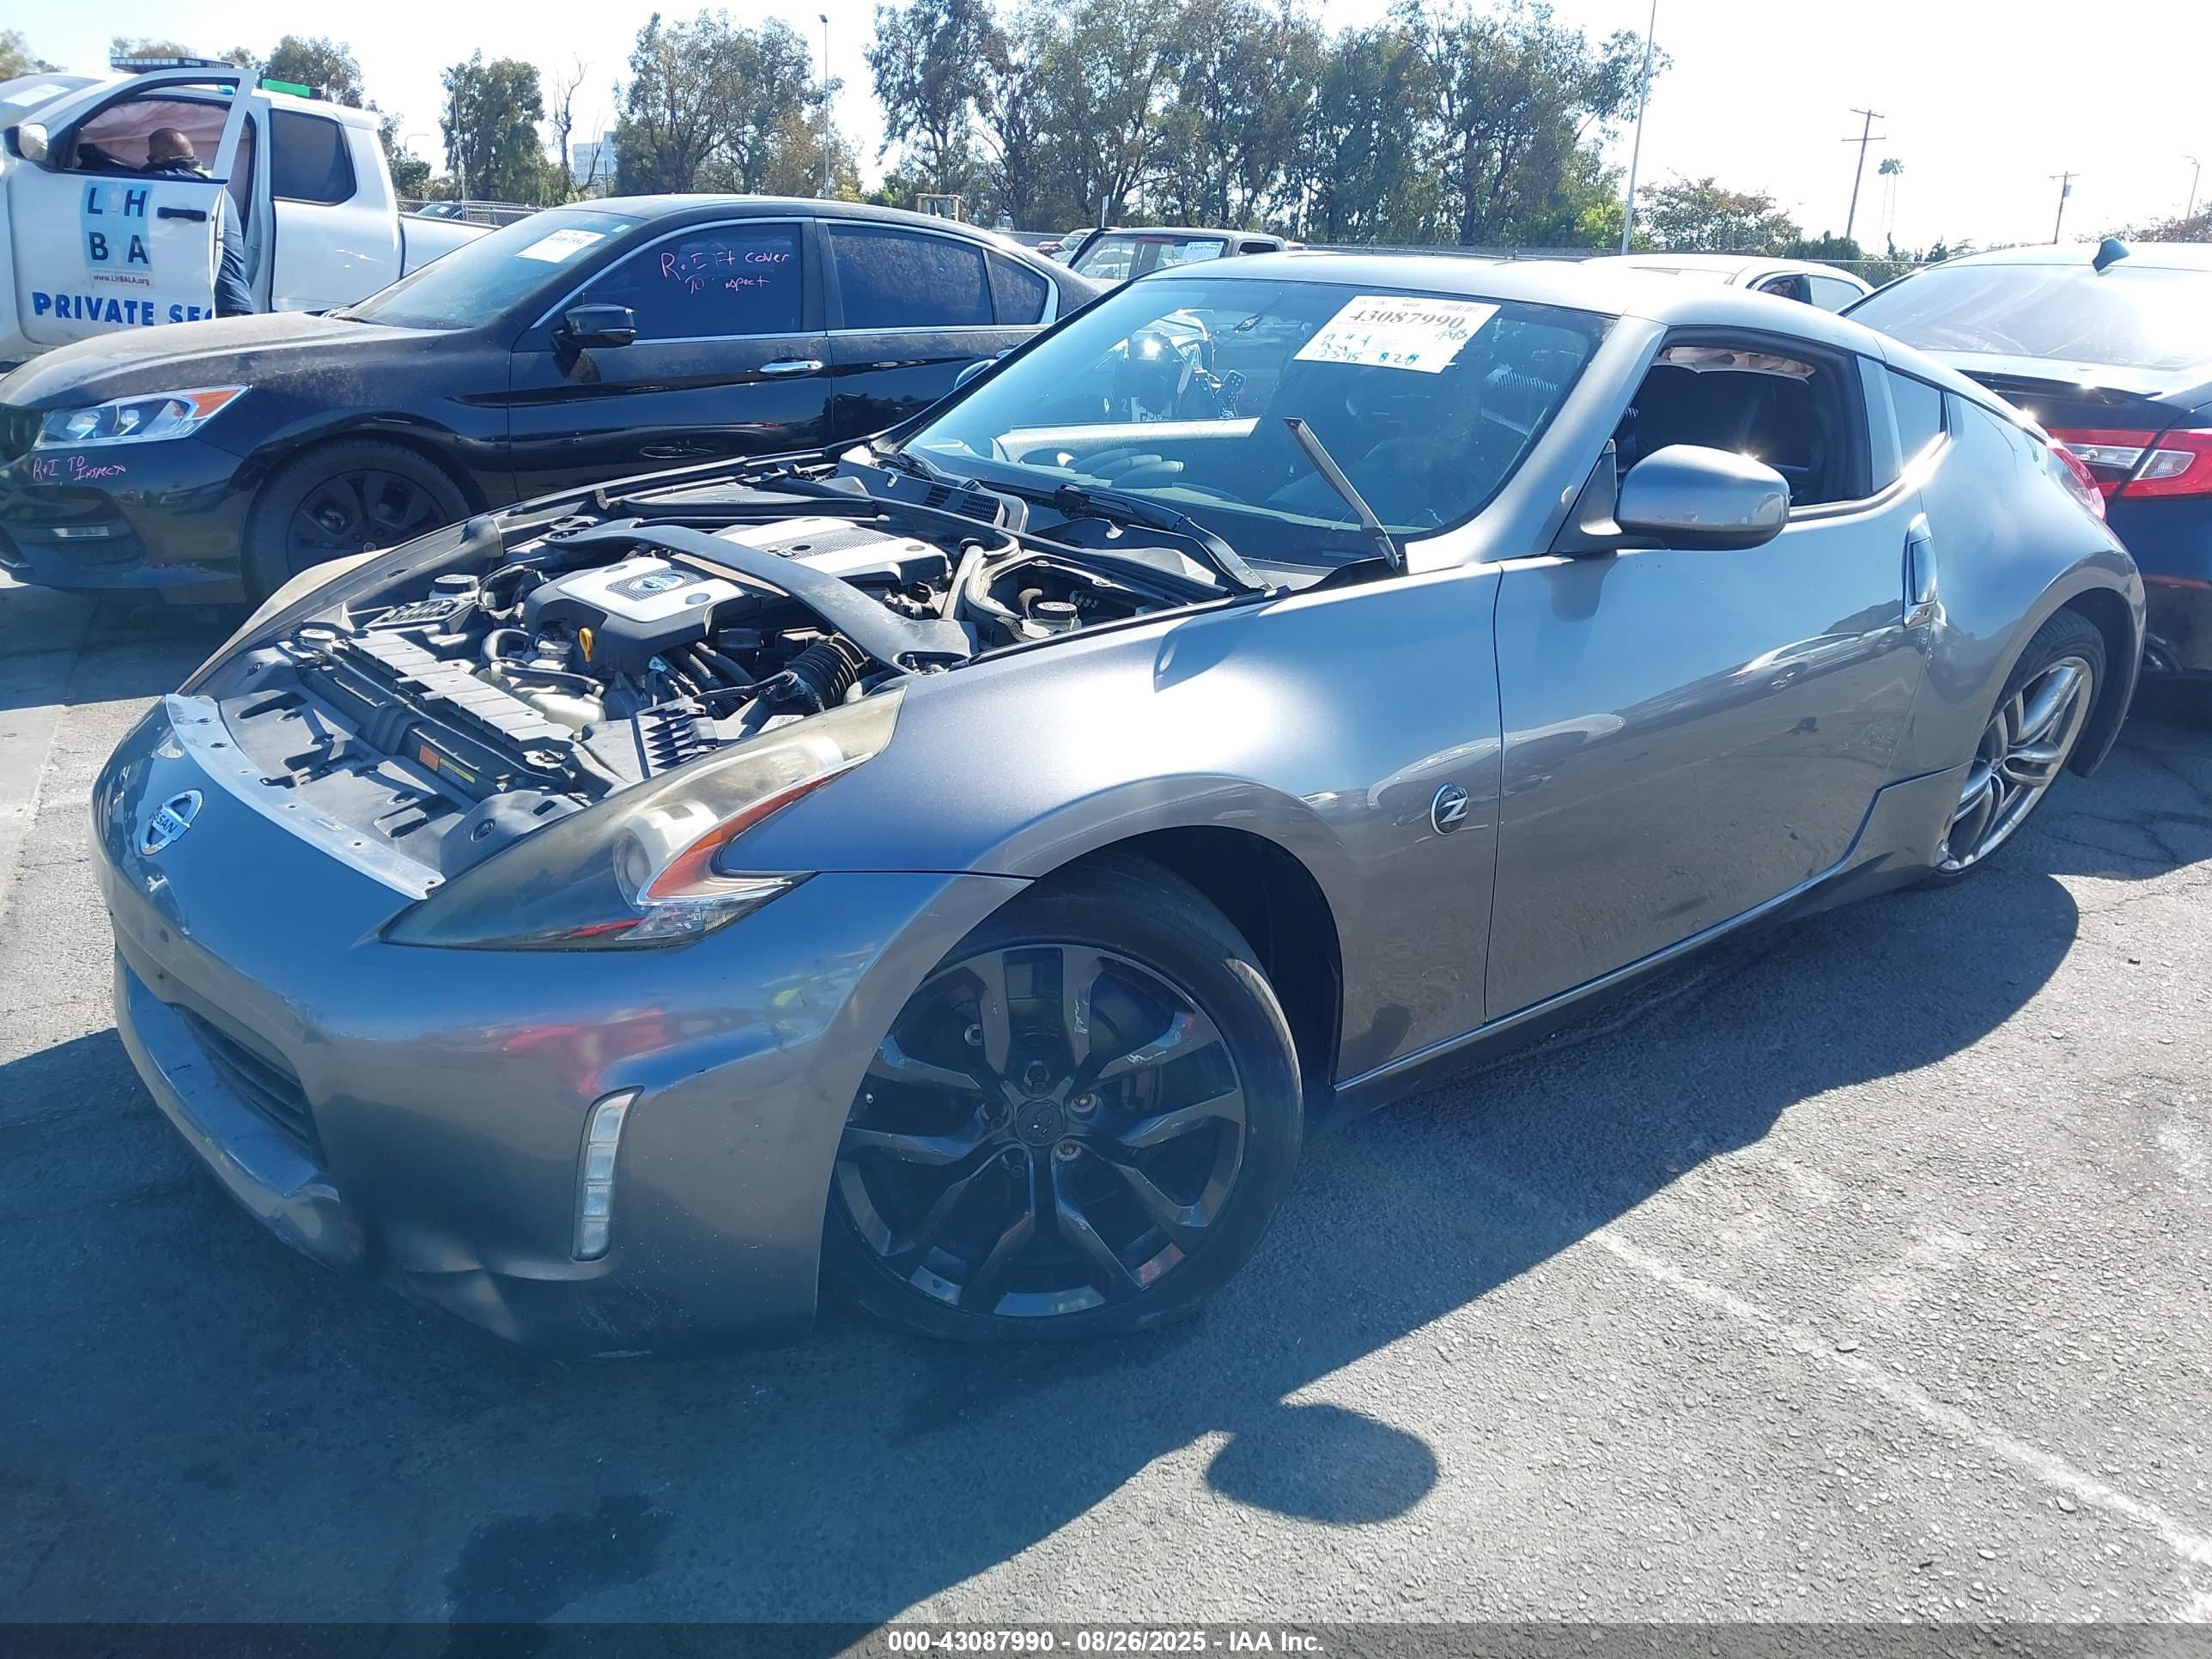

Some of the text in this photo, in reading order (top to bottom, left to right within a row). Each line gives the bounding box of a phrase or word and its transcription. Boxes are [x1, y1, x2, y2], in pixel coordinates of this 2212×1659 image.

[93, 275, 150, 286] www.LHBALA.org
[32, 291, 155, 326] PRIVATE
[1349, 310, 1466, 329] 43087990
